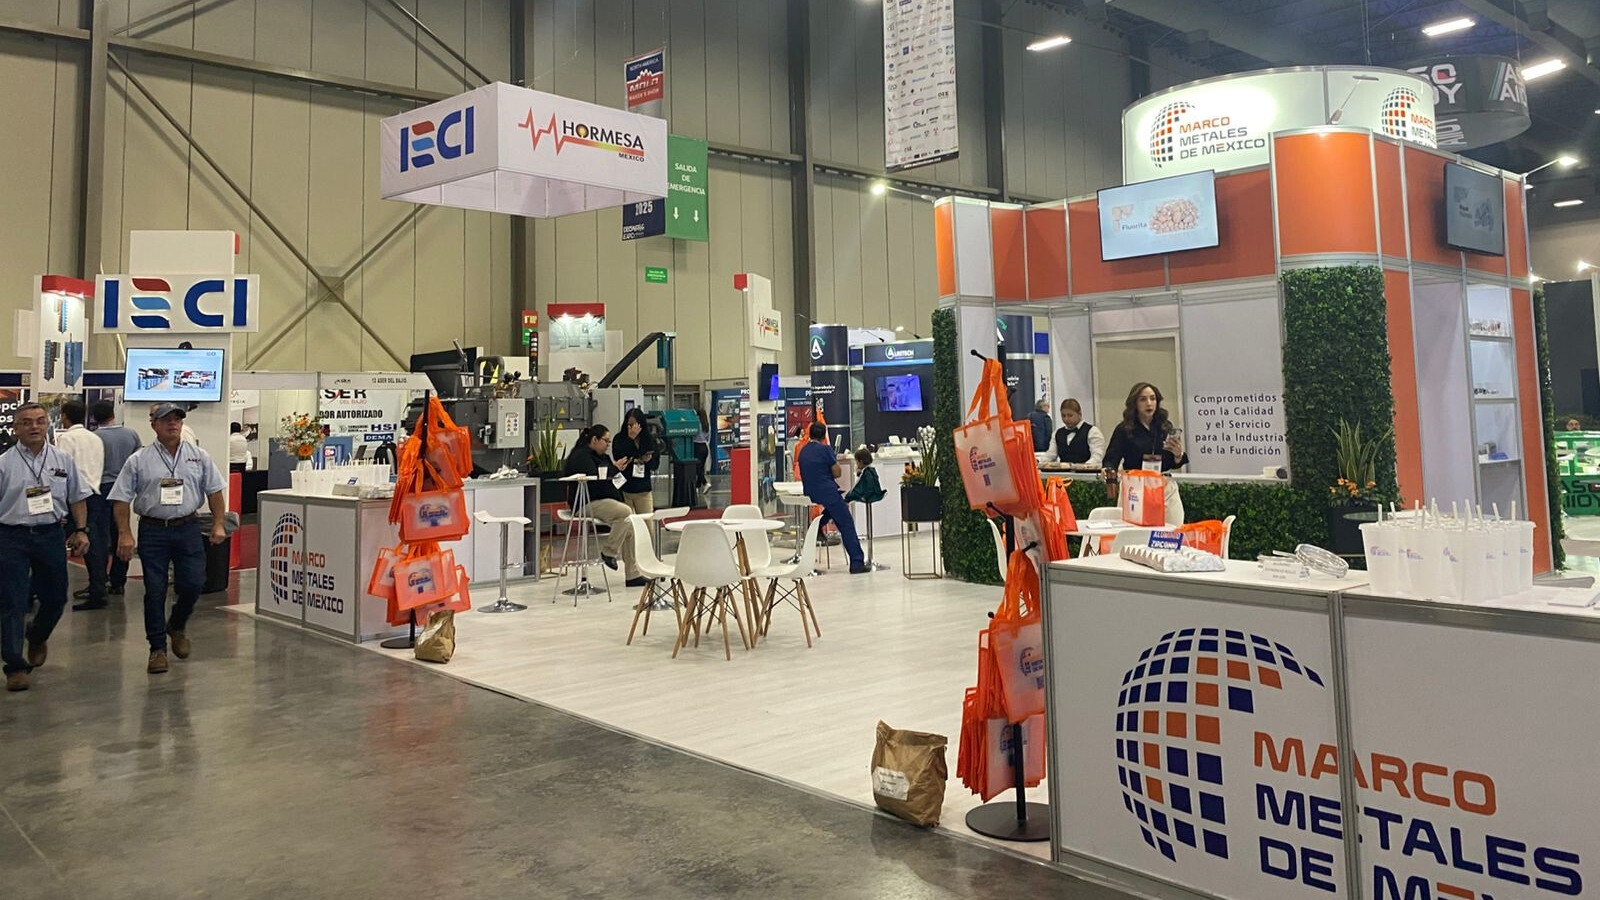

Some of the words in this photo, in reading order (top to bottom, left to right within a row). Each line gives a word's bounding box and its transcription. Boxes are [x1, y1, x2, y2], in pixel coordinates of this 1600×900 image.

[1179, 116, 1231, 134] MARCO
[400, 105, 475, 173] IECI
[562, 119, 645, 150] HORMESA
[1179, 127, 1248, 147] METALES
[618, 152, 645, 163] MEXICO
[1180, 148, 1199, 160] DE
[1202, 138, 1266, 156] MEXICO
[674, 162, 698, 173] SALIDA
[681, 175, 691, 183] DE
[635, 200, 654, 217] 2025
[1121, 222, 1148, 231] Fluorita
[103, 277, 248, 329] IECI
[1193, 393, 1277, 405] Comprometidos
[336, 409, 383, 419] AUTORIZADO
[1197, 407, 1216, 416] con
[1220, 406, 1230, 416] la
[1233, 406, 1274, 416] Calidad
[371, 423, 397, 431] HSI
[1206, 421, 1212, 431] y
[1215, 420, 1225, 429] el
[1228, 420, 1271, 429] Servicio
[1195, 433, 1218, 443] para
[1222, 432, 1231, 441] la
[1235, 432, 1284, 443] Industria
[1200, 445, 1213, 455] de
[1216, 445, 1226, 455] la
[1229, 445, 1281, 456] Fundición
[292, 550, 326, 568] MARCO
[292, 569, 335, 591] METALES
[292, 589, 303, 605] DE
[307, 591, 344, 614] MEXICO
[1254, 731, 1497, 816] MARCO
[1255, 783, 1583, 896] METALES
[1259, 835, 1337, 893] DE
